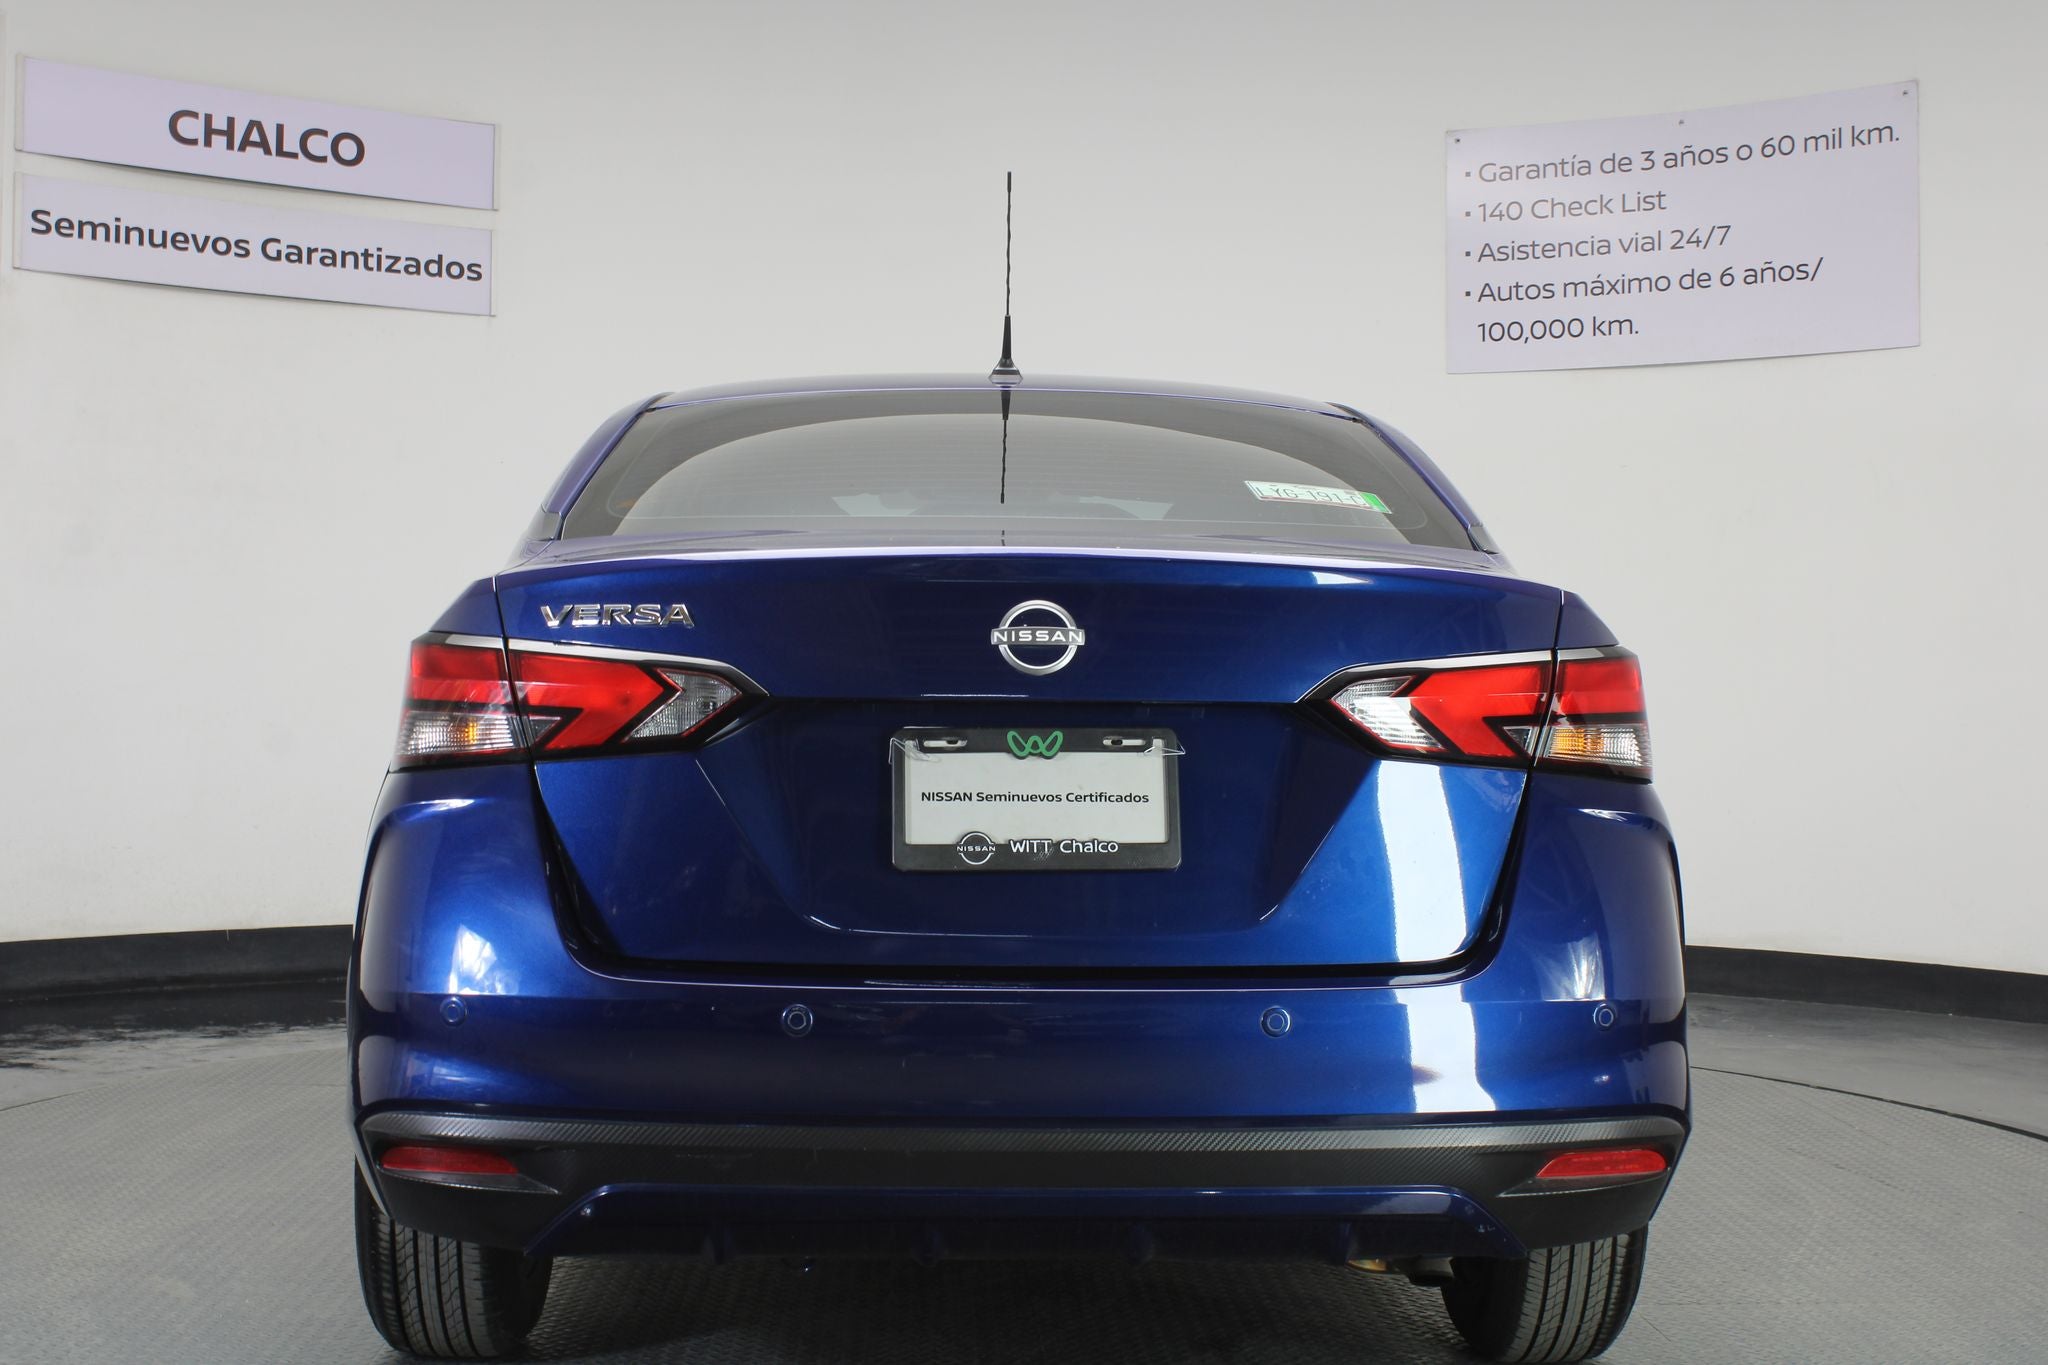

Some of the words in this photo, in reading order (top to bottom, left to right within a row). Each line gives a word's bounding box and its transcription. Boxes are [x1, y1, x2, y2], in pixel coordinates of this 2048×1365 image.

[169, 110, 365, 166] CHALCO
[1479, 154, 1591, 182] Garantía
[1600, 153, 1632, 174] de
[1641, 151, 1655, 170] 3
[1664, 145, 1728, 168] años
[1737, 145, 1752, 160] o
[1761, 135, 1795, 158] 60
[1804, 127, 1841, 152] mil
[1852, 126, 1899, 147] km.
[1478, 201, 1522, 222] 140
[1531, 194, 1614, 219] Check
[1622, 191, 1667, 212] List
[31, 210, 250, 258] Seminuevos
[261, 238, 482, 281] Garantizados
[1478, 236, 1610, 262] Asistencia
[1619, 230, 1661, 253] vial
[1670, 225, 1731, 249] 24/7
[1478, 282, 1555, 302] Autos
[1564, 274, 1670, 297] máximo
[1679, 269, 1711, 290] de
[1720, 267, 1734, 286] 6
[1744, 257, 1823, 285] años/
[1478, 318, 1584, 343] 100,000
[1593, 316, 1638, 336] km.
[540, 603, 695, 627] VERSA
[993, 630, 1082, 642] NISSAN
[922, 792, 972, 801] NISSAN
[976, 792, 1062, 802] Seminuevos
[1066, 792, 1149, 802] Certificados
[1010, 839, 1052, 853] WITT
[1060, 839, 1119, 853] Chalco
